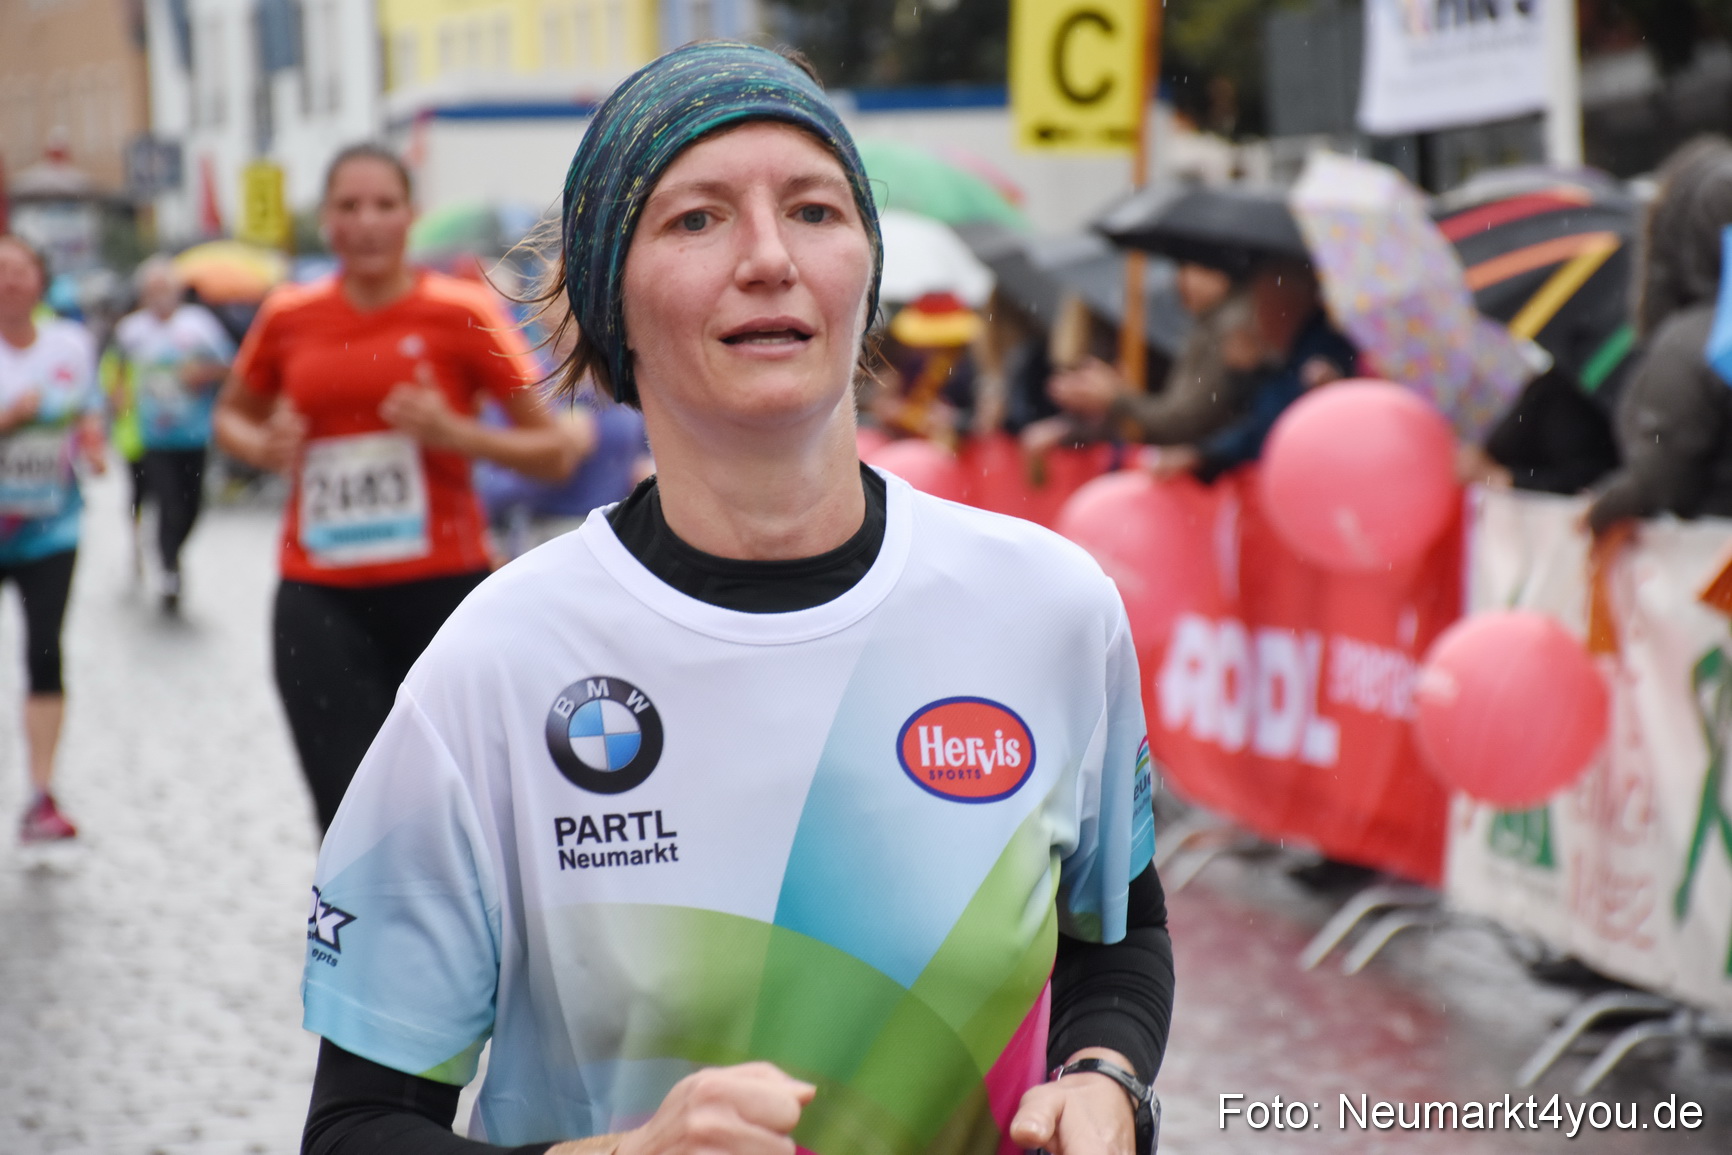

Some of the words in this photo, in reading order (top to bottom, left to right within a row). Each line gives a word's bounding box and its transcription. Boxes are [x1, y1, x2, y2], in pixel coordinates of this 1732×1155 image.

[1051, 8, 1115, 109] C
[553, 678, 651, 720] BMW
[918, 725, 1022, 775] Hervis
[928, 768, 982, 781] SPORTS
[554, 810, 678, 847] PARTL
[558, 842, 679, 871] Neumarkt
